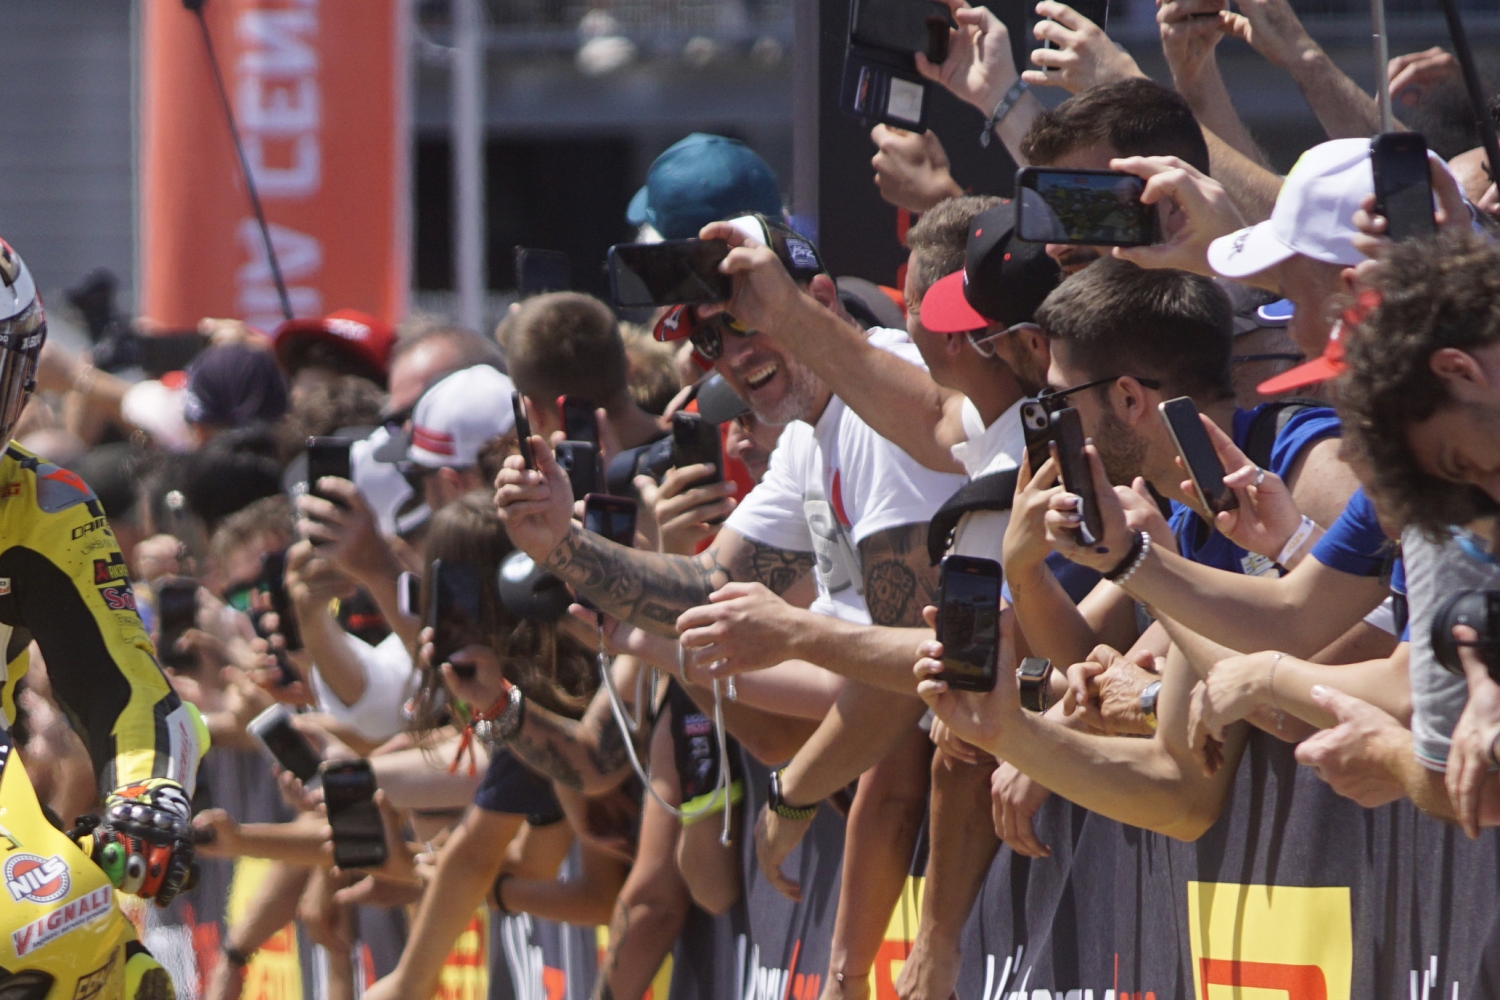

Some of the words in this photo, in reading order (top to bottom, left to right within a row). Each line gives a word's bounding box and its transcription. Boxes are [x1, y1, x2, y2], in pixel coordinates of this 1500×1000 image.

[236, 0, 322, 198] CEN
[7, 857, 68, 901] NILS
[13, 886, 110, 957] VIGNALI
